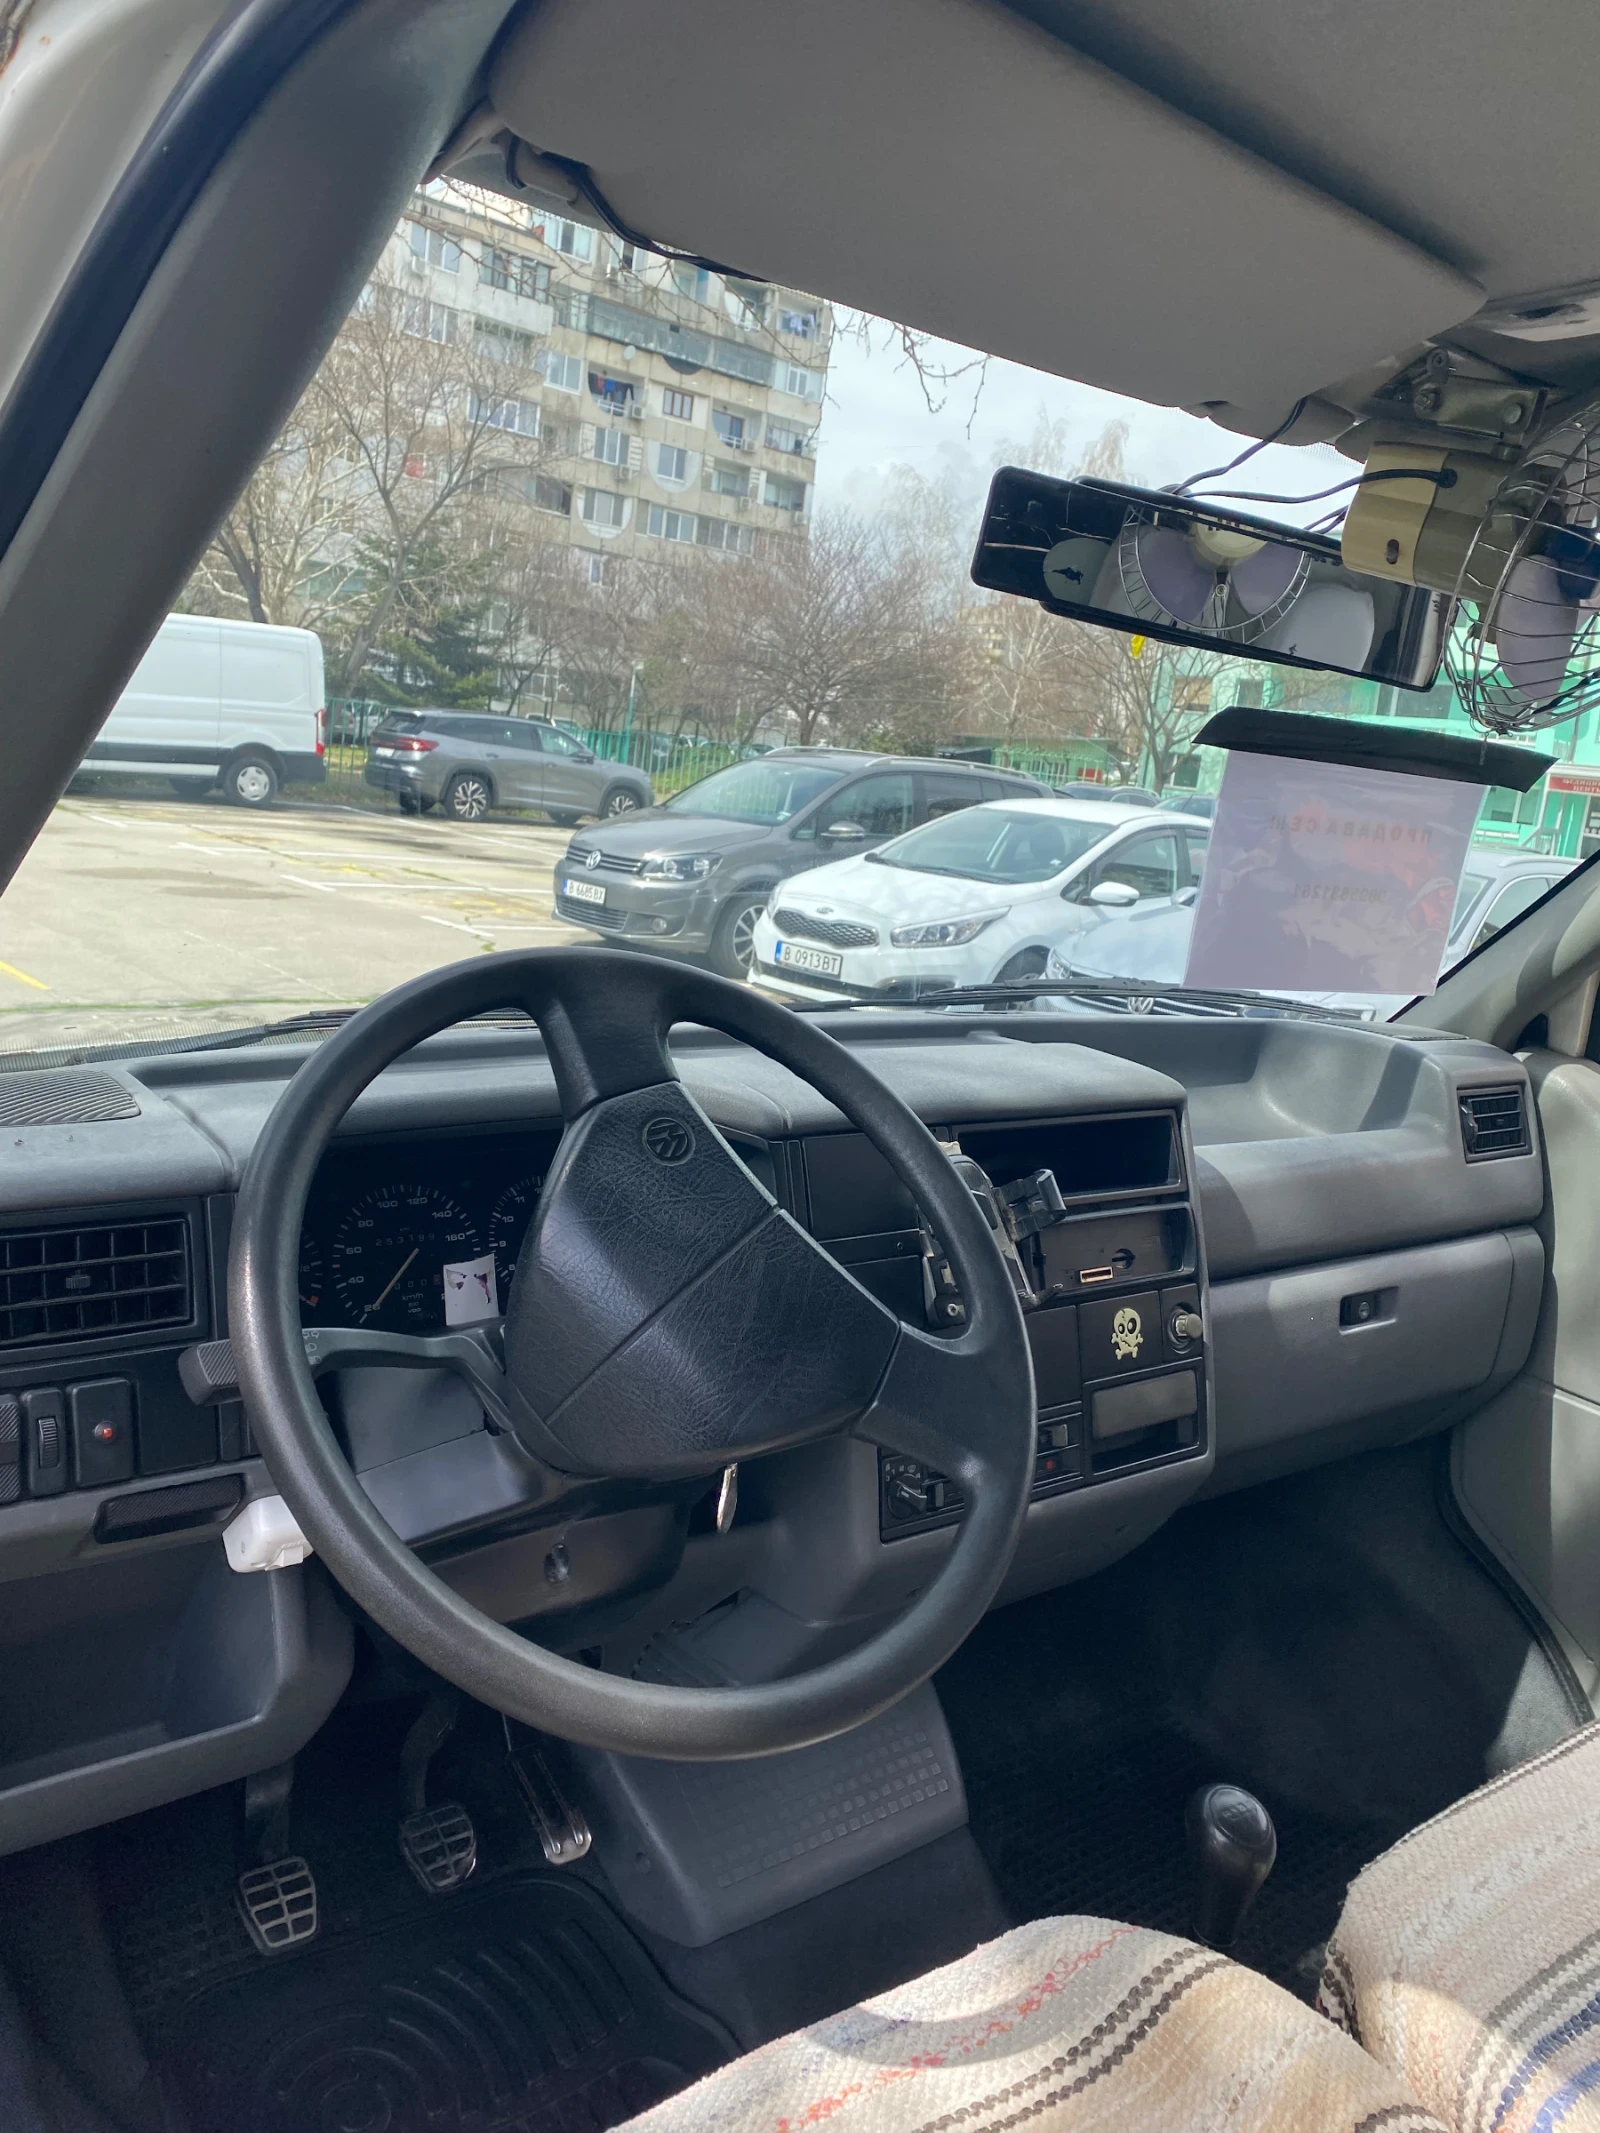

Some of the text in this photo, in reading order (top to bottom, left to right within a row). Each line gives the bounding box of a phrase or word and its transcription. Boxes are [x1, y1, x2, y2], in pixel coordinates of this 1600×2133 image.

[376, 1199, 399, 1209] 100
[406, 1196, 428, 1206] 120
[514, 1196, 525, 1204] 11
[431, 1209, 453, 1219] 140
[357, 1218, 374, 1228] 80
[501, 1215, 514, 1224] 10
[444, 1232, 466, 1242] 160
[499, 1240, 507, 1248] 9
[345, 1246, 363, 1255] 60
[348, 1275, 365, 1285] 40
[401, 1292, 424, 1301] km/h
[363, 1303, 381, 1313] 20
